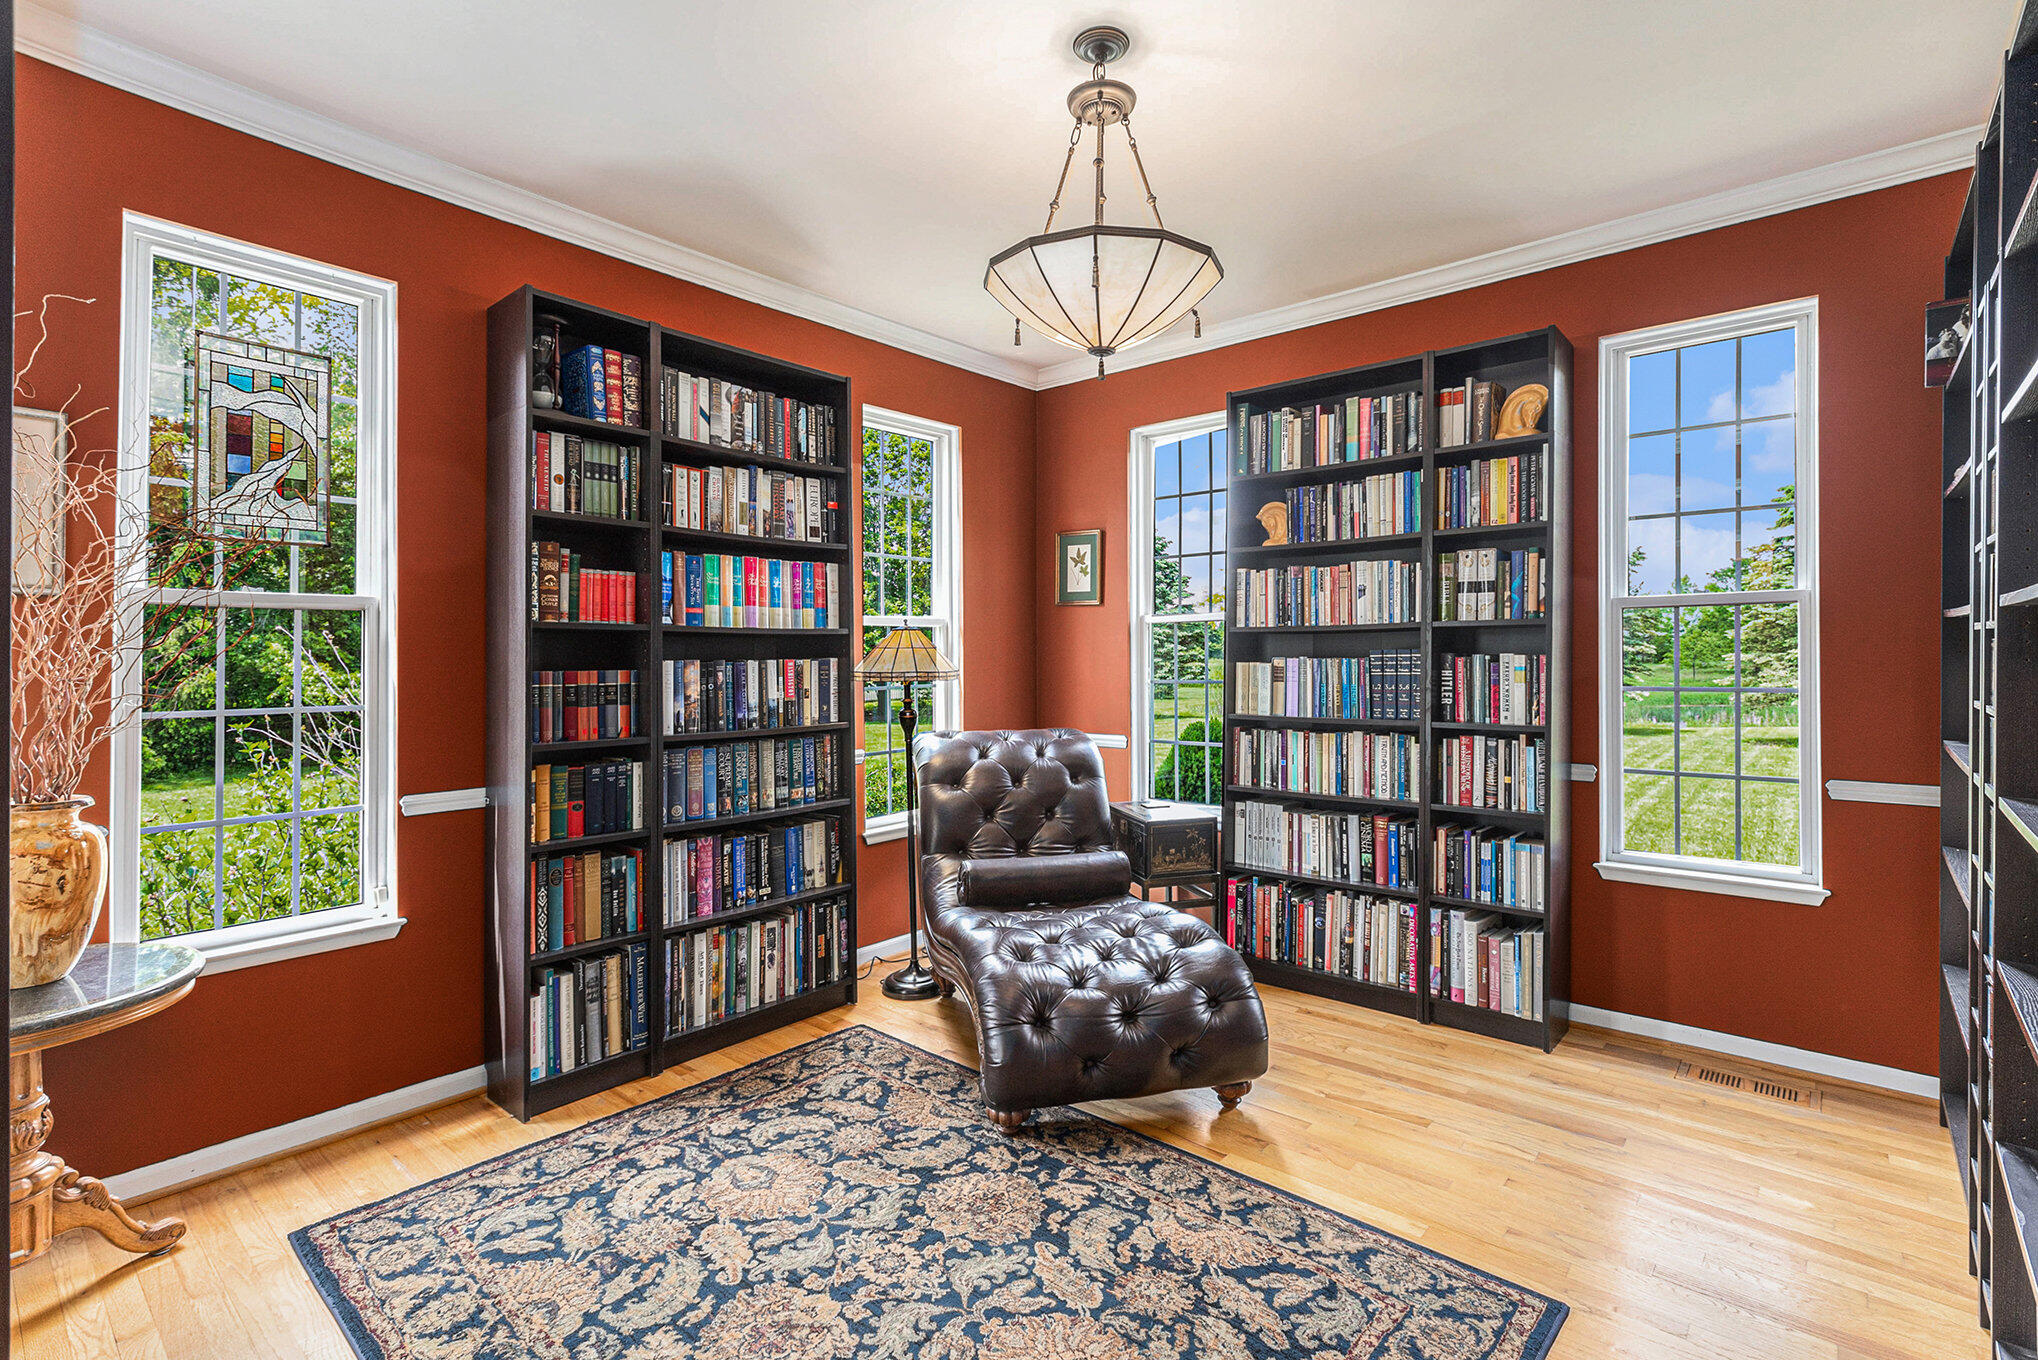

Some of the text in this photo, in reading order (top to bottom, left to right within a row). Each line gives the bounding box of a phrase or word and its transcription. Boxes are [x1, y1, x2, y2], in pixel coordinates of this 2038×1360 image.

[810, 484, 819, 524] EUROPE
[1442, 670, 1452, 704] HITLER
[637, 956, 645, 989] MALEREI
